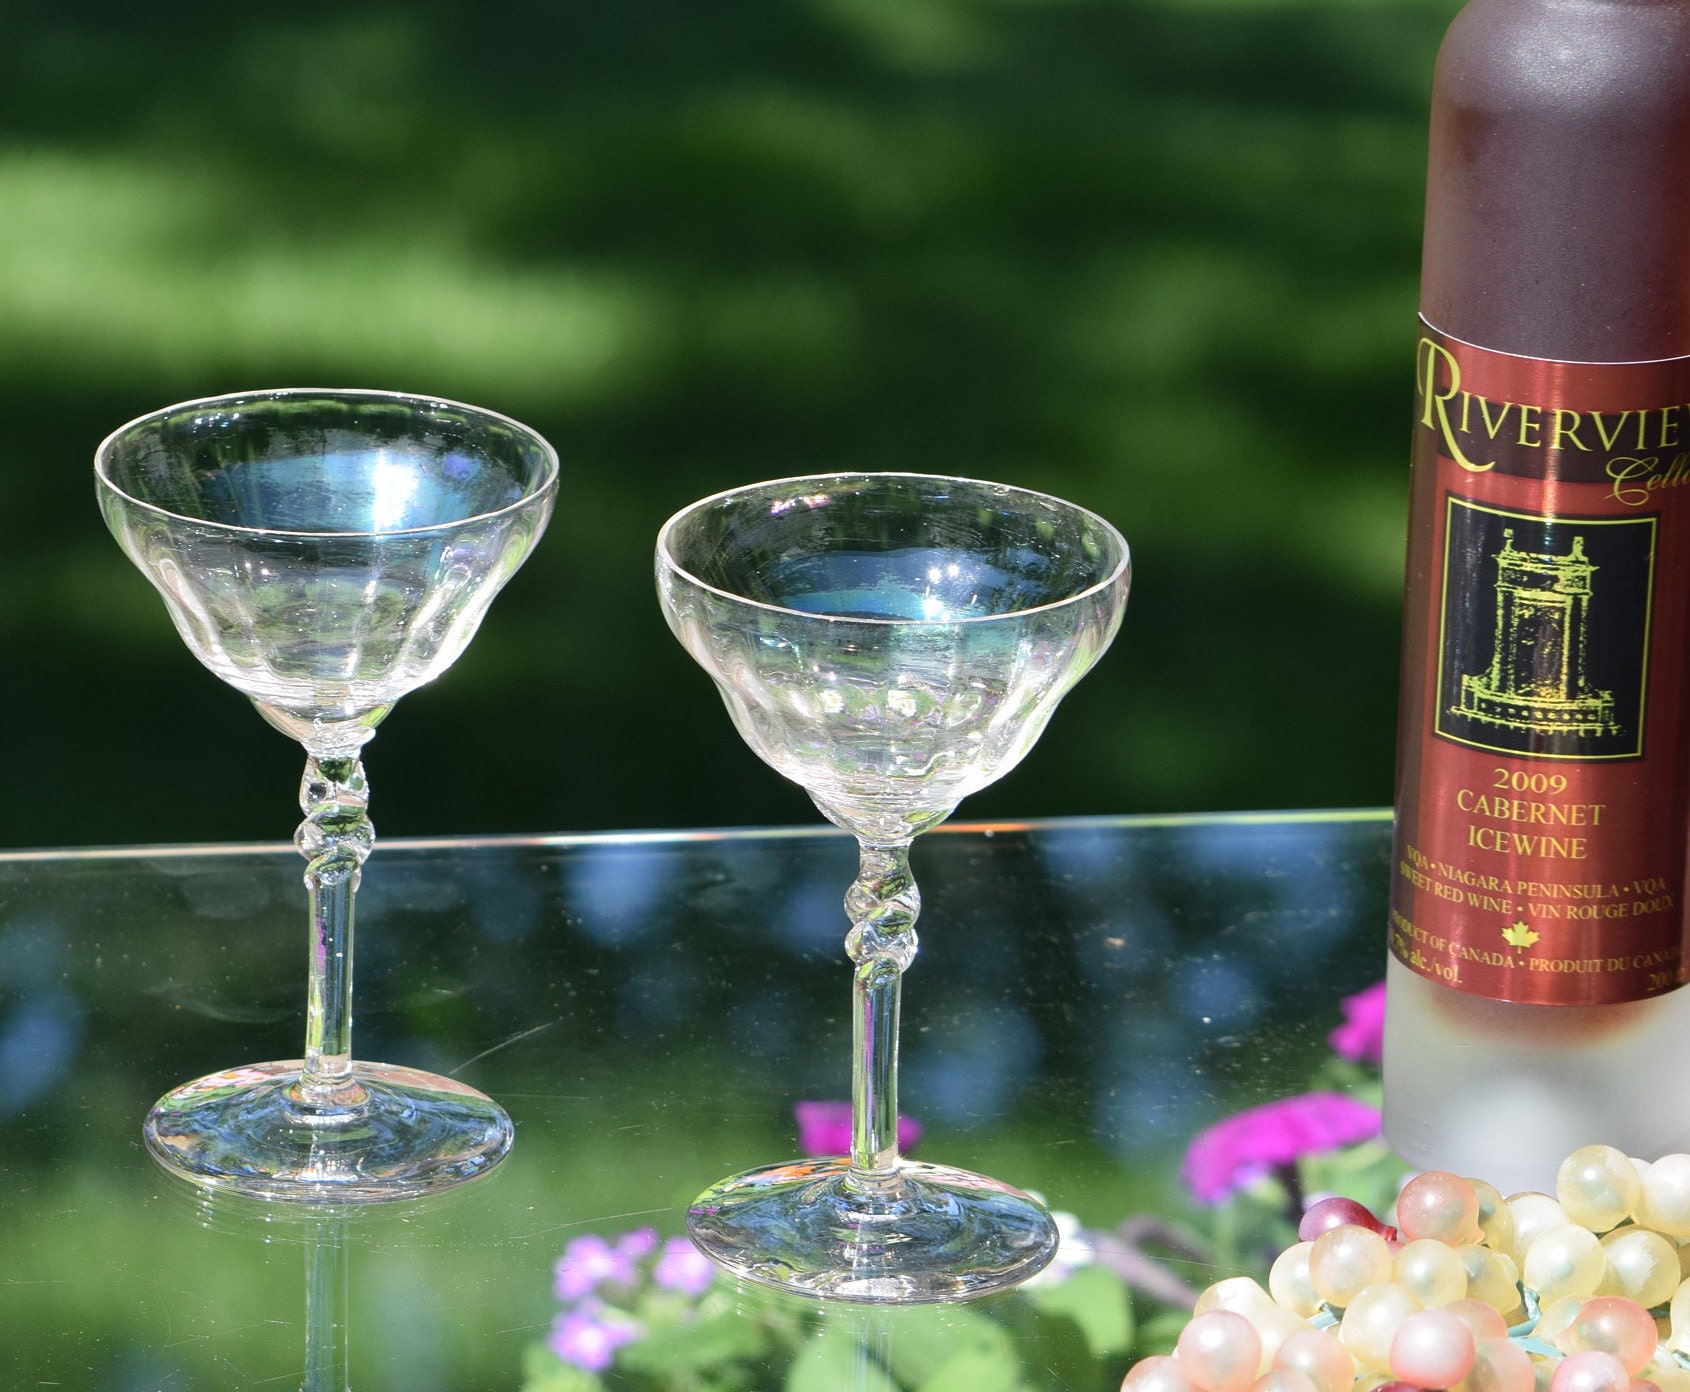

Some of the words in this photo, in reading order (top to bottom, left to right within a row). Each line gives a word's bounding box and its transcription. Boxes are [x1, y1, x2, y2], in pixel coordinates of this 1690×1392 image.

[1417, 337, 1690, 472] RIVERVIE
[1493, 768, 1567, 794] 2009
[1457, 789, 1606, 826] CABERNET
[1468, 825, 1588, 859] ICEWINE
[1400, 861, 1433, 892] SWEET
[1434, 881, 1463, 903] RED
[1467, 893, 1512, 914] WINE
[1528, 903, 1562, 920] VIN
[1566, 903, 1629, 920] ROUGE
[1407, 845, 1429, 870] VQA
[1438, 862, 1513, 894] NIAGARA
[1517, 881, 1619, 899] PENINSULA
[1633, 878, 1666, 895] VQA
[1430, 935, 1447, 951] OF
[1448, 942, 1515, 969] CANADA
[1529, 959, 1604, 973] PRODUIT
[1607, 957, 1631, 972] DU
